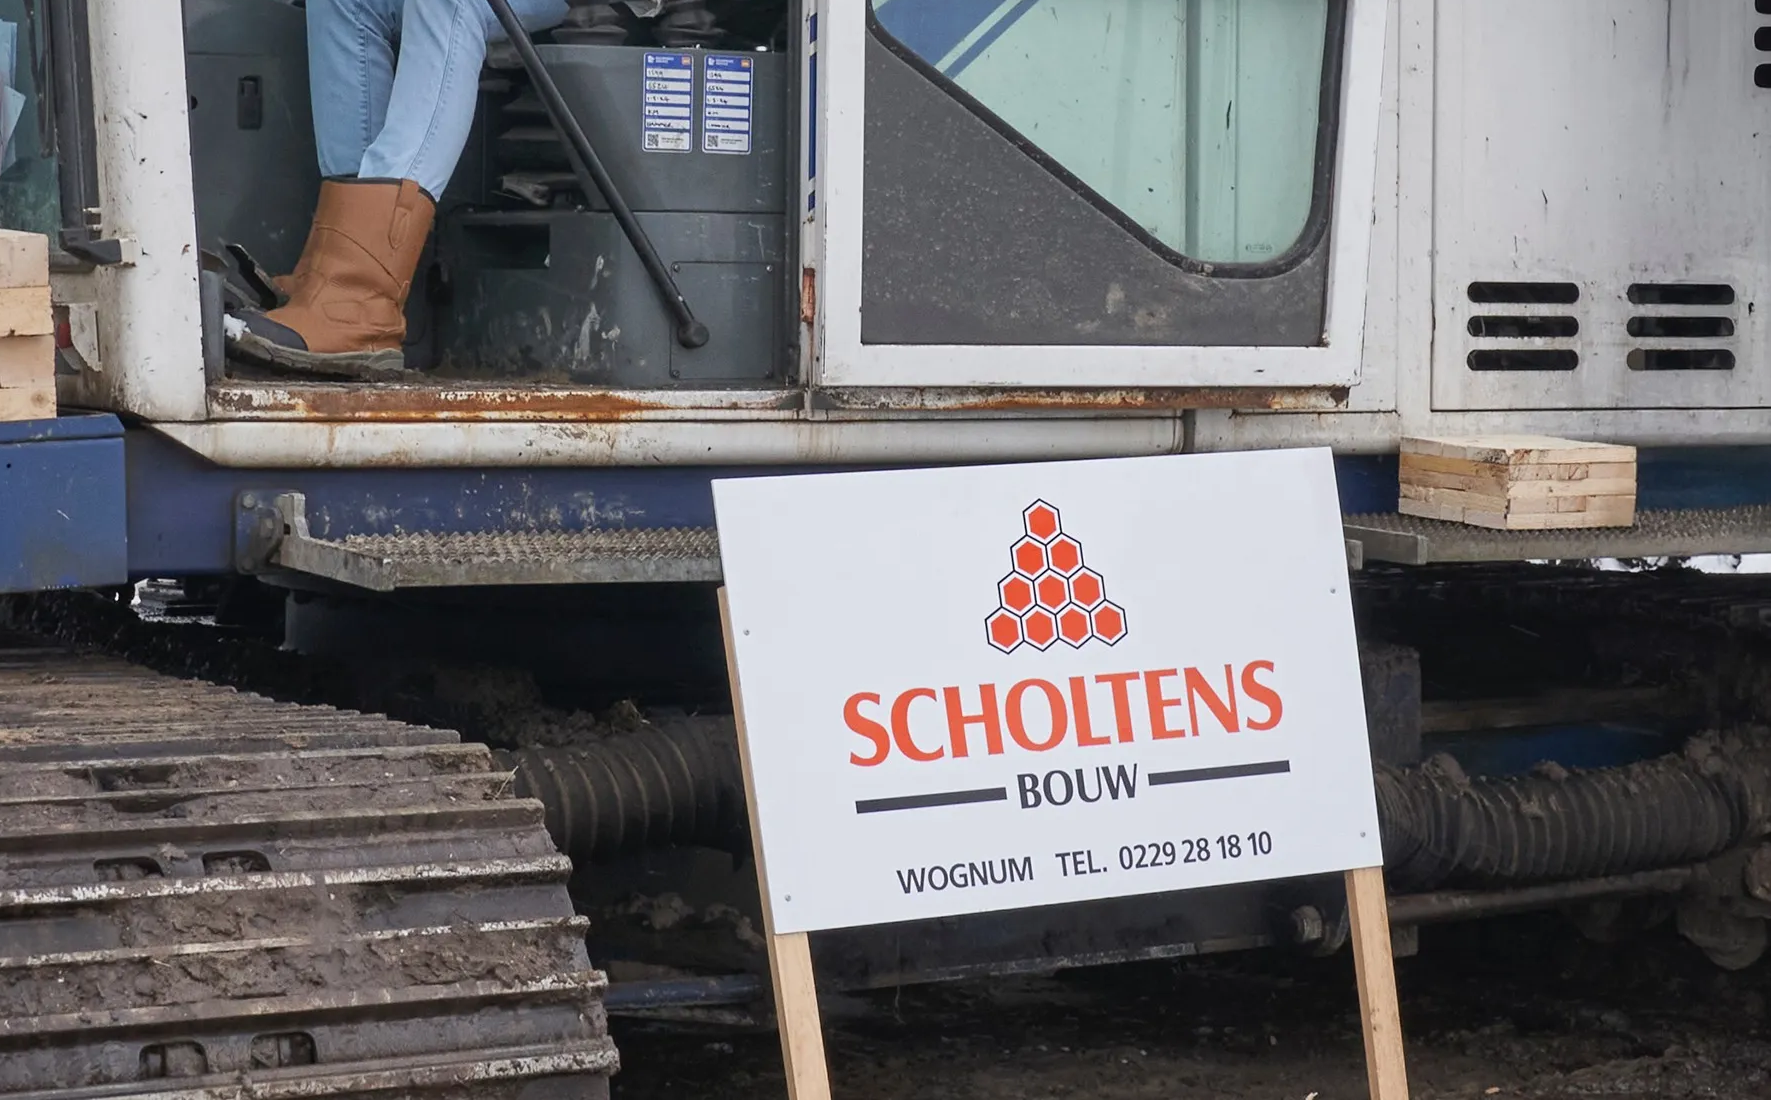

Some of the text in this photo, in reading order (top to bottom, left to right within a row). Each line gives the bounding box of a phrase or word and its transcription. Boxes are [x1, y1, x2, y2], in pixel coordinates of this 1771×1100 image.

[844, 661, 1282, 766] SCHOLTENS
[1017, 763, 1137, 809] BOUW
[896, 831, 1271, 893] WOGNUM TEL. 0229 28 18 10
